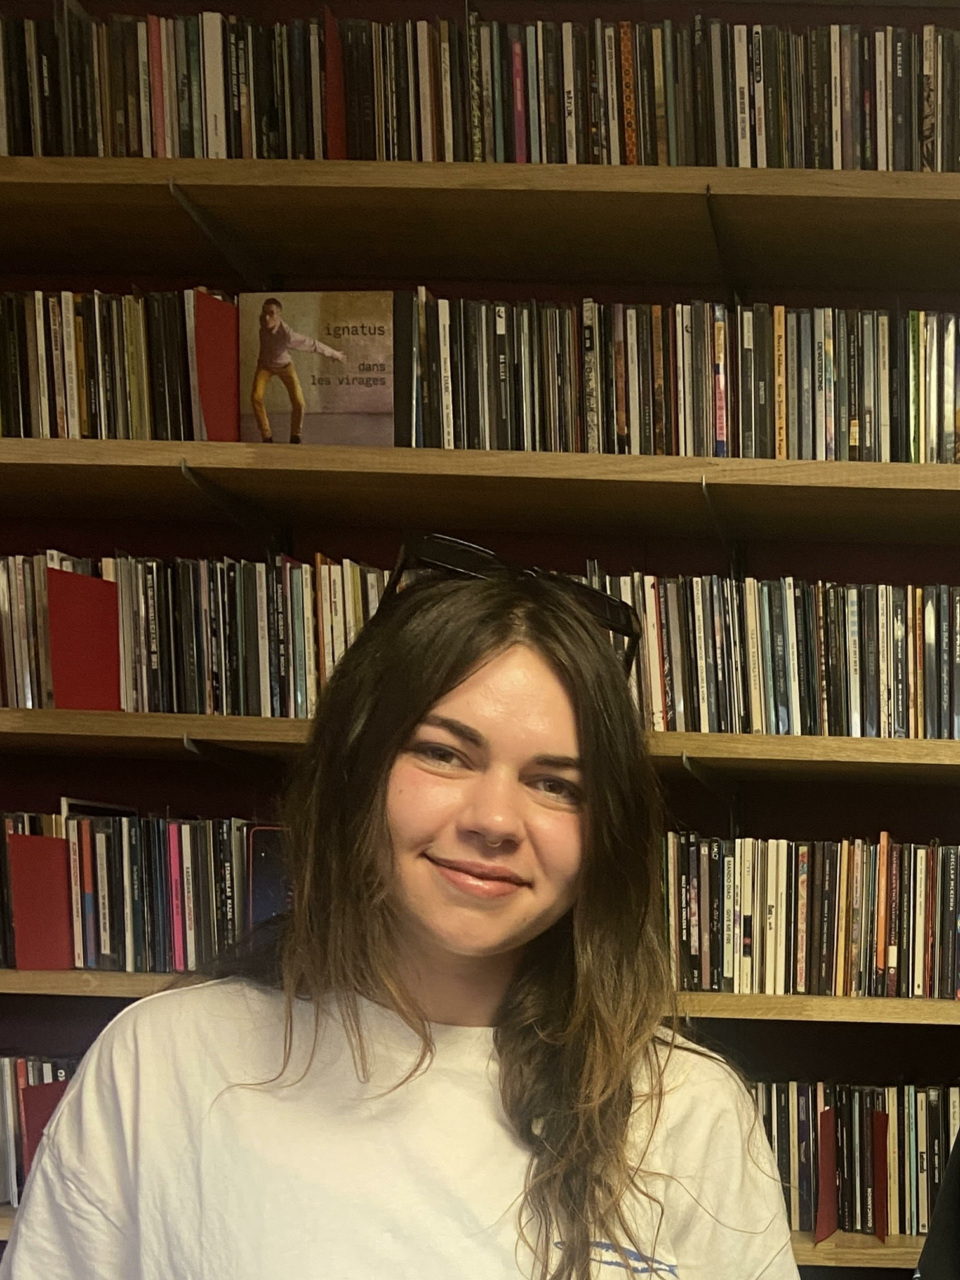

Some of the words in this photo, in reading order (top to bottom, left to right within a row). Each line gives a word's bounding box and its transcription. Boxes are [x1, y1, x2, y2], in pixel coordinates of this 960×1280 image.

[325, 323, 385, 338] ignatus
[358, 361, 385, 372] dans
[312, 375, 331, 386] les
[338, 375, 385, 388] virages
[279, 644, 286, 655] ME
[224, 862, 232, 896] STANISLAS
[726, 923, 732, 932] ME
